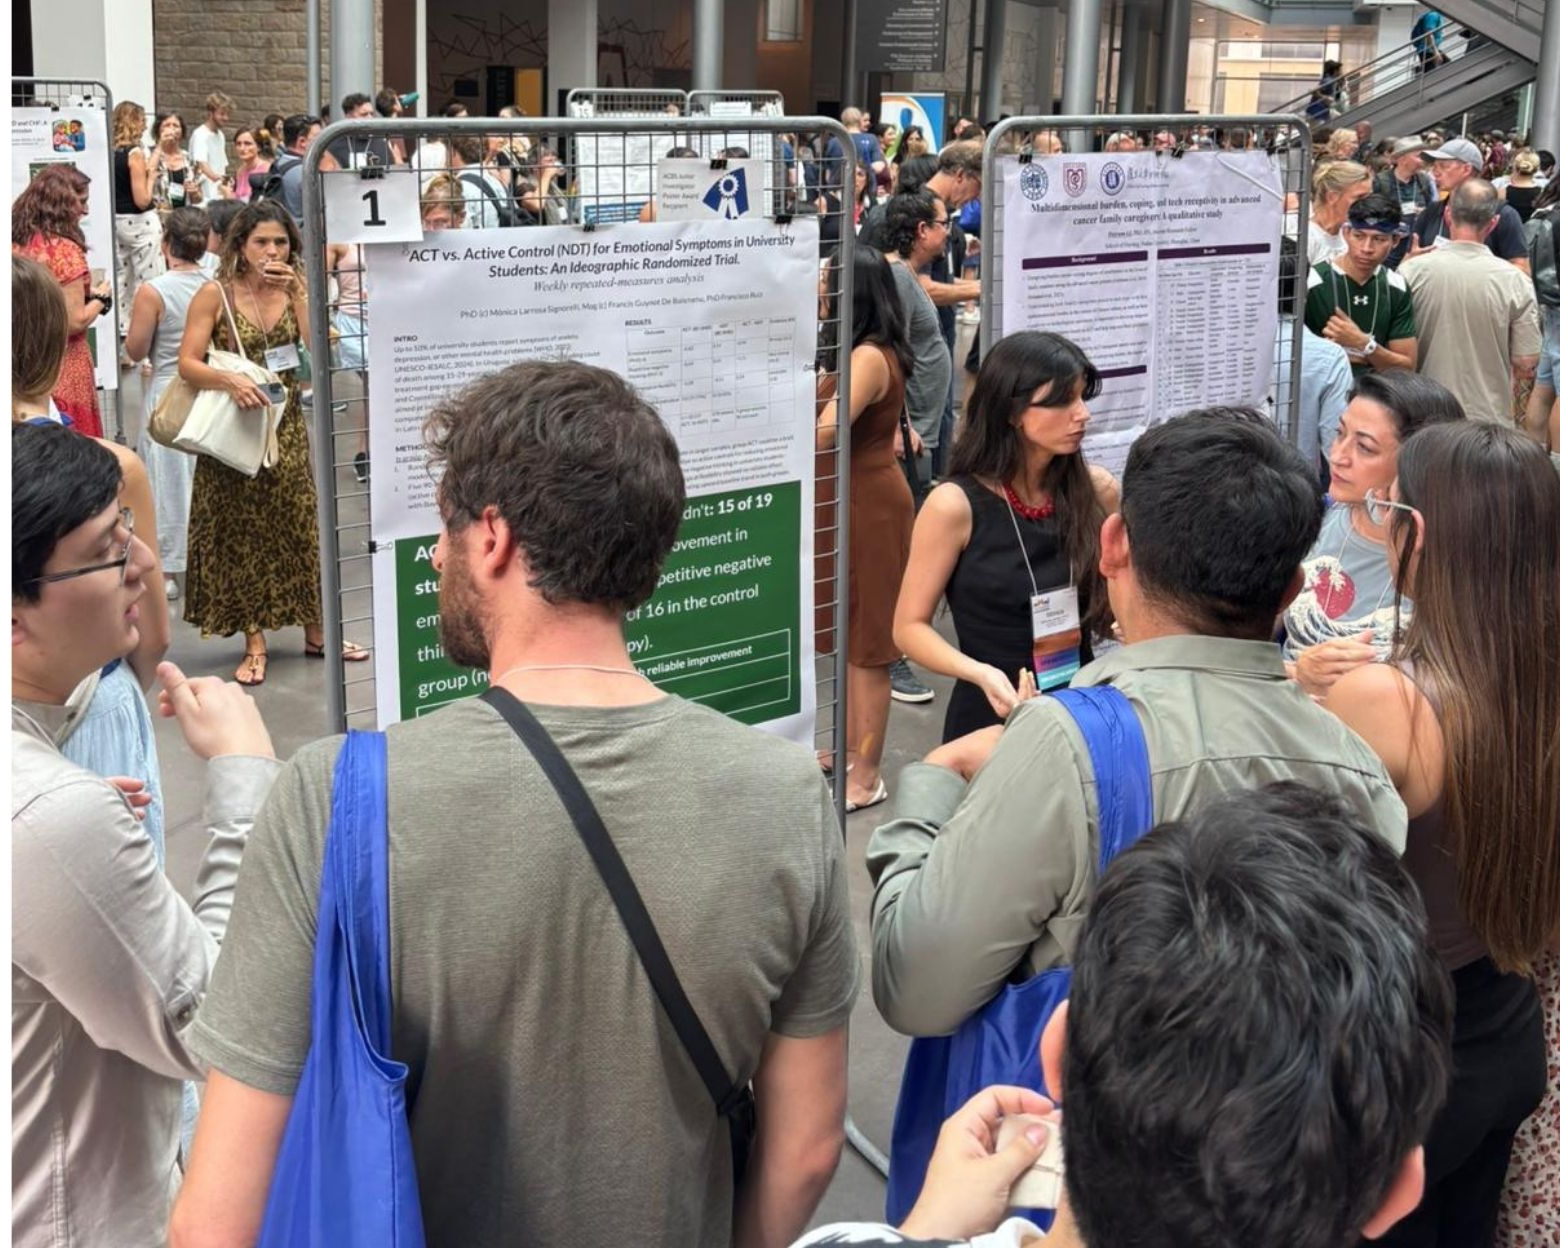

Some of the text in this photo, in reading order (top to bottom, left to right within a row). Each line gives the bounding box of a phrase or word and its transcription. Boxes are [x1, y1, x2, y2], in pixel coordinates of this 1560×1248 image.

[363, 190, 386, 226] 1
[1031, 201, 1098, 213] Multidimensional
[1100, 199, 1127, 210] burden,
[1169, 197, 1182, 207] tech
[1184, 196, 1218, 207] receptivity
[1220, 196, 1226, 204] in
[1228, 194, 1261, 204] advanced
[1073, 216, 1097, 225] cancer
[1099, 214, 1121, 226] family
[1168, 209, 1204, 221] qualitative
[1206, 208, 1222, 219] study
[409, 234, 795, 262] ACT vs. Active Control (NDT) for Emotional Symptoms in University
[489, 254, 740, 278] Students: An Ideographic Randomized Trial.
[683, 493, 773, 519] dn't: 15 of 19
[672, 528, 748, 551] ovement in
[657, 554, 772, 588] petitive negative
[626, 583, 759, 621] of 16 in the control
[647, 645, 753, 676] reliable improvement
[418, 674, 468, 698] group
